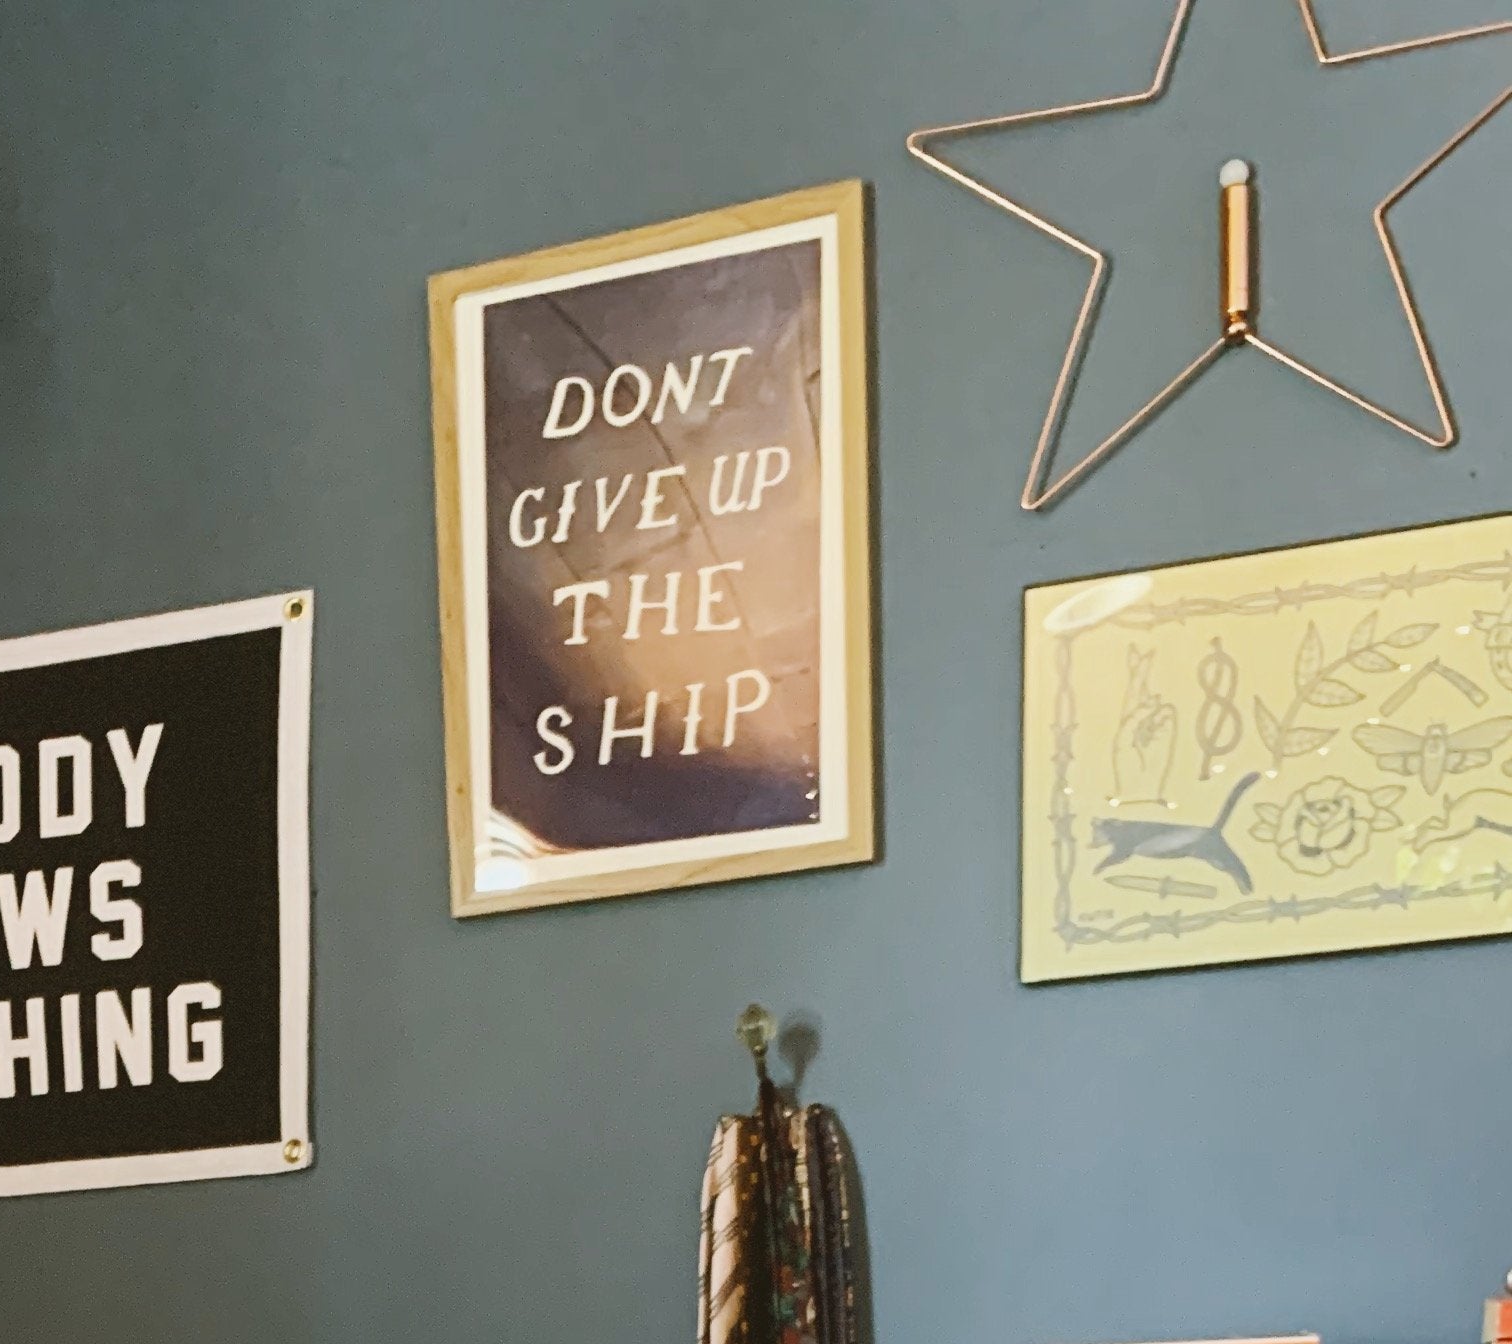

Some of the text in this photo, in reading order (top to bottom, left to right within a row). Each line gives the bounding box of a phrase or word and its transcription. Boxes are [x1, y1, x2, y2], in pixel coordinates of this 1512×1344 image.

[542, 346, 753, 439] DONT
[508, 445, 791, 548] GIVE UP
[553, 561, 745, 645] THE
[533, 669, 771, 776] SHIP
